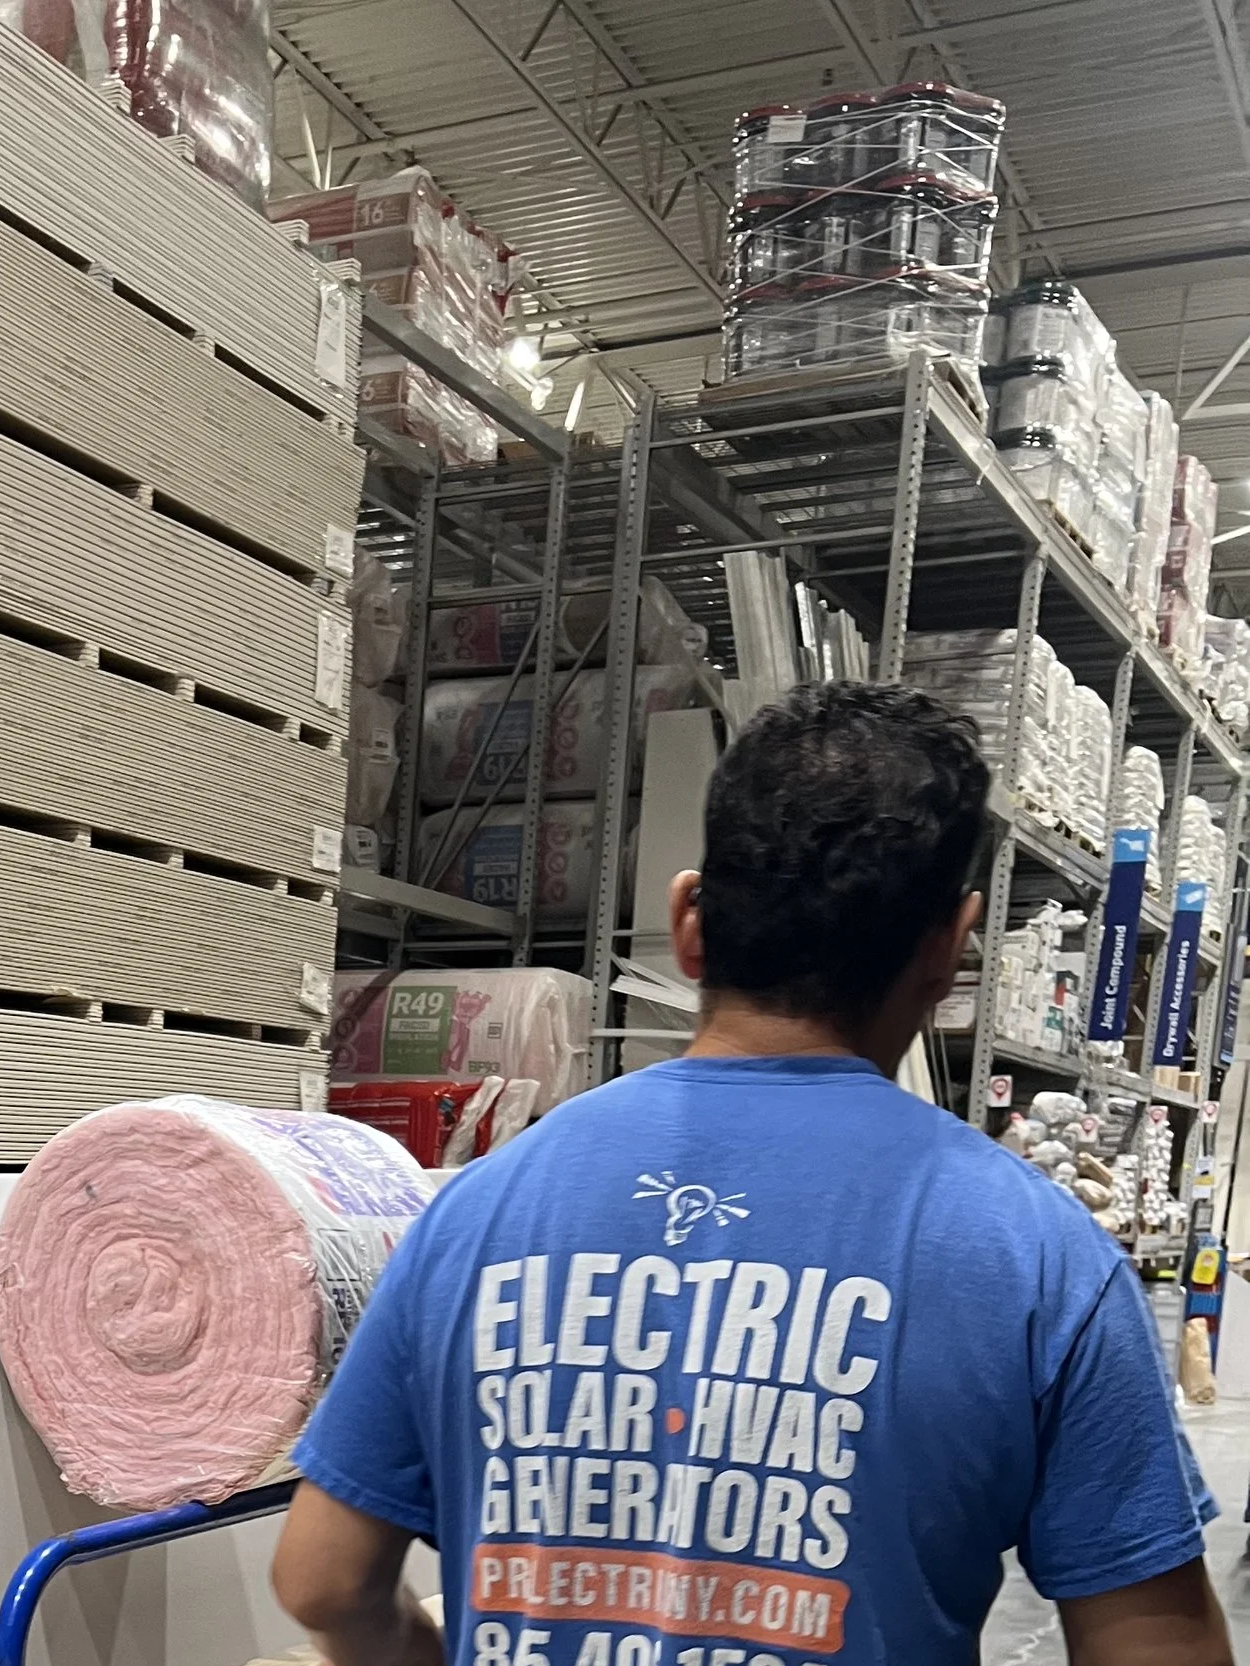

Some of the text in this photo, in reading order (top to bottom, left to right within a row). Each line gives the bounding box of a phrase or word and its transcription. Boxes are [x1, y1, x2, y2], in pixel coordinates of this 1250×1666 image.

[391, 991, 446, 1016] R49
[1100, 925, 1127, 1031] Joint Compound
[473, 1252, 893, 1396] ELECTRIC
[477, 1368, 865, 1481] SOLAR HVAC
[480, 1455, 852, 1570] GENERATORS
